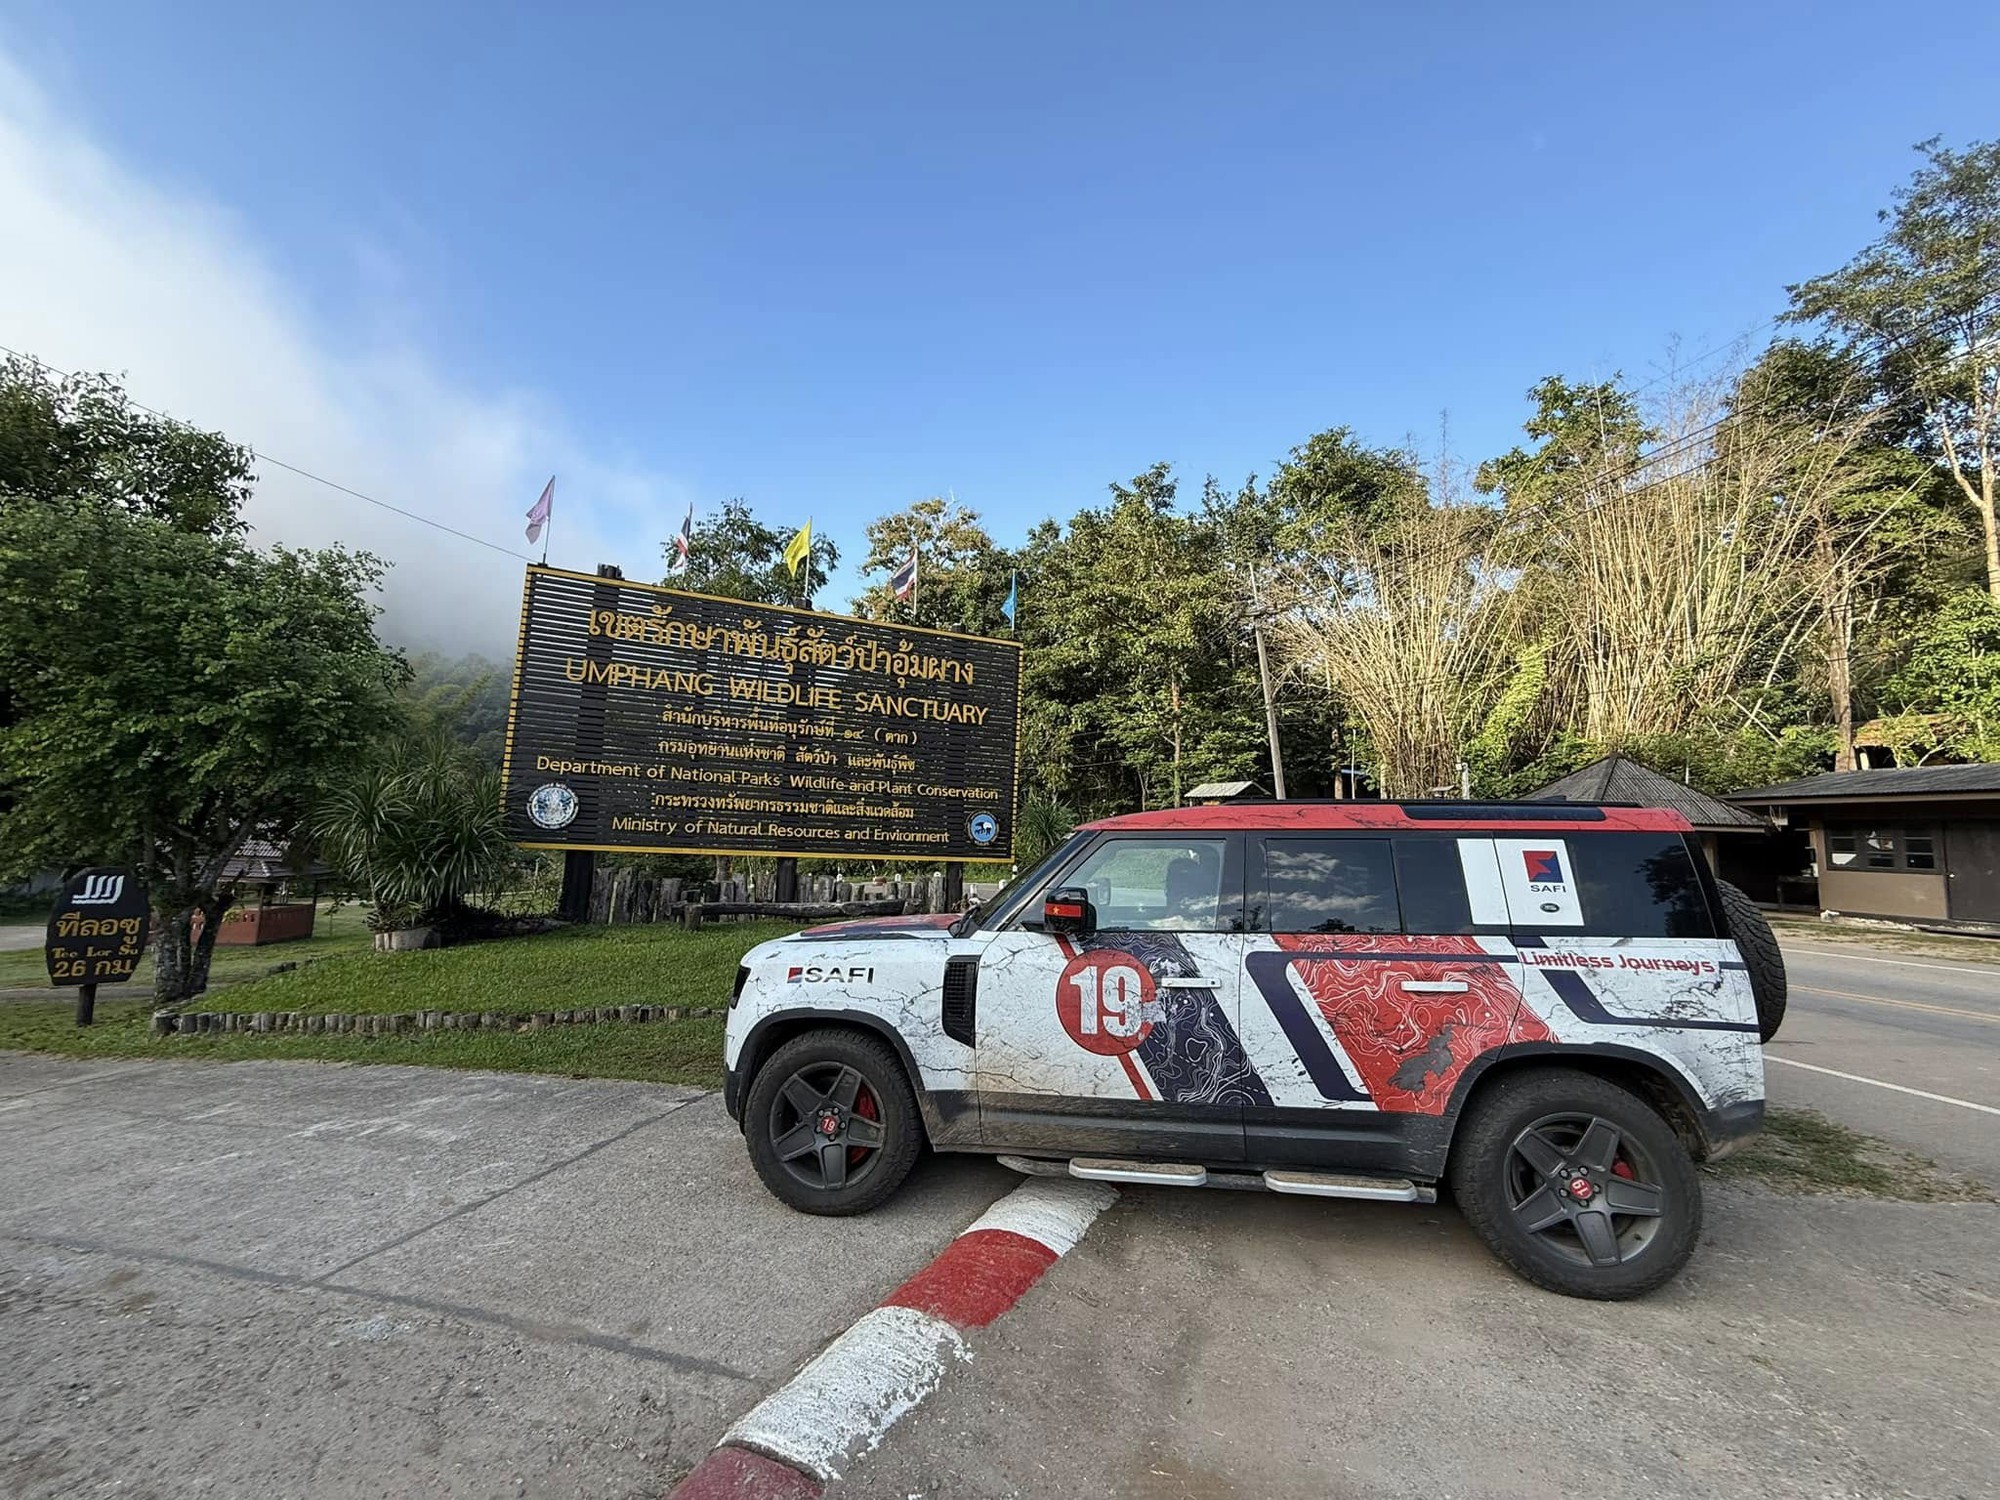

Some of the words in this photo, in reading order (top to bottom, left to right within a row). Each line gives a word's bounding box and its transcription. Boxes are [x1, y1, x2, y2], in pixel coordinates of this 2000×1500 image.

[588, 604, 974, 689] เขตรักษาพันธุ์สัตว์ป่าอุ้มผาง
[565, 657, 714, 696] UMPHANG
[729, 675, 842, 710] WILDLIFE
[854, 691, 989, 726] SANCTUARY
[662, 703, 835, 740] สำนักบริหารพื้นที่อนุรักษ์ที่
[658, 740, 786, 762] กรมอุทยานแห่งชาติ
[795, 746, 837, 765] สัตว์ป่า
[847, 753, 916, 775] และพันธุ์พืช
[536, 756, 641, 777] Department
[646, 765, 666, 778] of
[670, 766, 736, 784] National
[741, 771, 780, 786] Parks
[789, 774, 845, 790] Wildlife
[849, 779, 875, 792] and
[878, 780, 913, 795] Plant
[917, 783, 998, 800] Conservation
[654, 793, 914, 819] กระทรวงทรัพยากรธรรมชาติและสิ่งแวดล้อม
[611, 817, 678, 834] Ministry
[684, 819, 702, 834] of
[707, 821, 762, 837] Natural
[768, 823, 840, 839] Resources
[844, 826, 870, 840] and
[874, 828, 950, 843] Environment
[1530, 884, 1567, 893] SAFI
[56, 911, 142, 945] ทีลอซู
[86, 946, 113, 957] Lor
[1518, 950, 1615, 969] Limitless
[1618, 954, 1715, 976] Journeys
[52, 960, 87, 978] 26
[804, 967, 874, 984] SAFI
[1069, 965, 1142, 1038] 19
[823, 1118, 836, 1131] 19
[1571, 1179, 1588, 1196] 19
